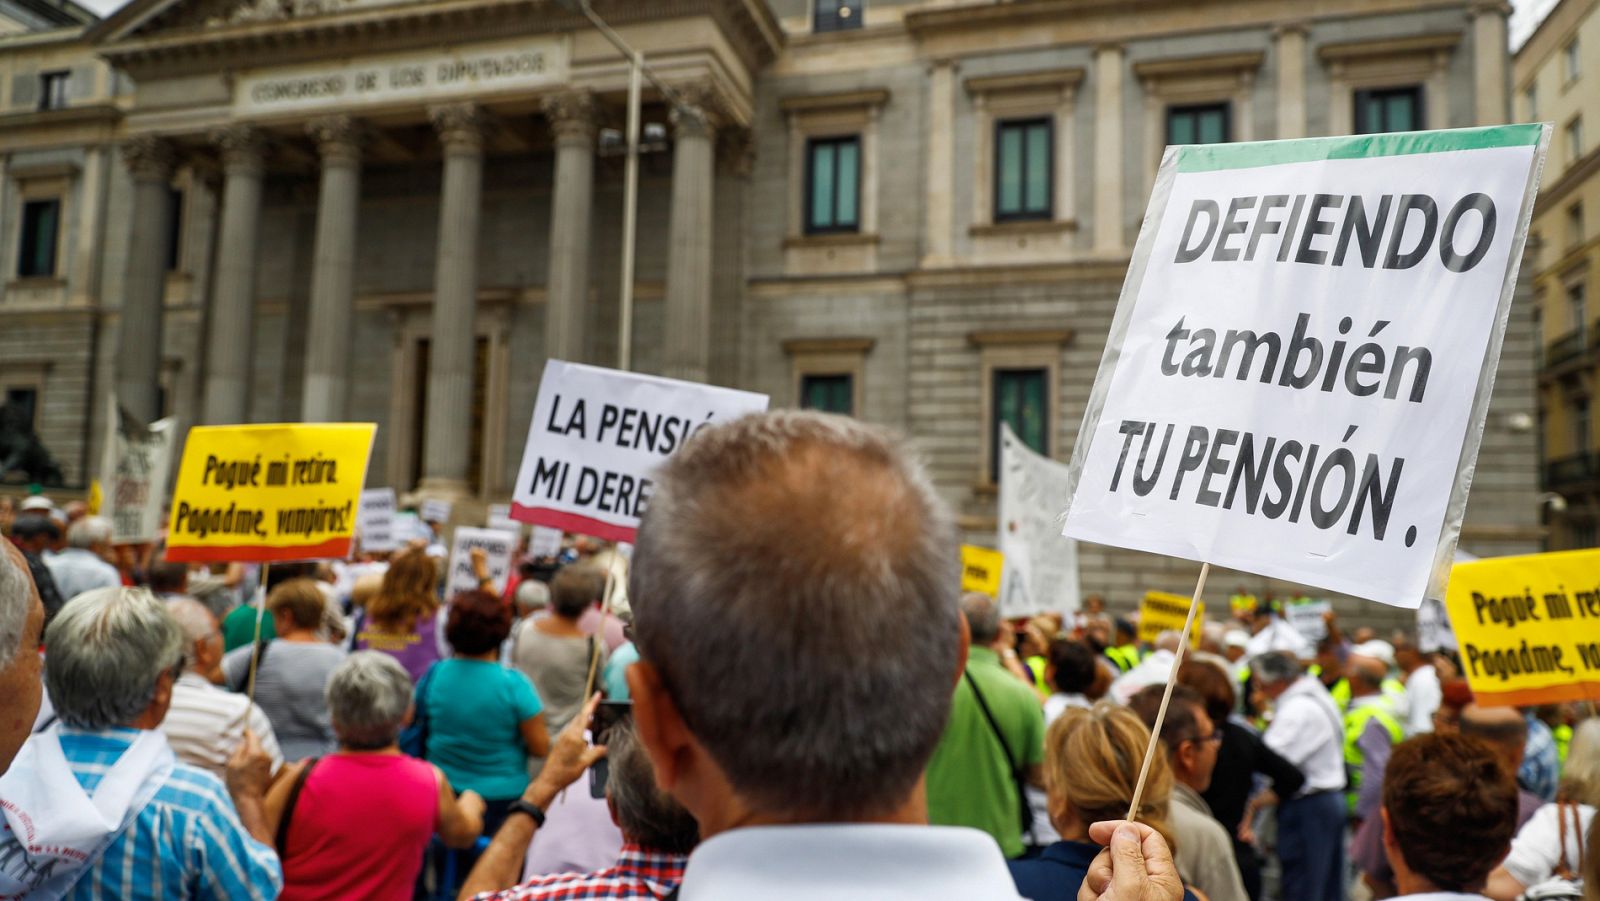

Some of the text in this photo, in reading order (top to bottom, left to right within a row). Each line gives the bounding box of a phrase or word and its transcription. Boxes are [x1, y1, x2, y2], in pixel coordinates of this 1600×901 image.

[251, 52, 545, 102] CONGRESO DE LOS DIPUTADOS
[1173, 192, 1498, 273] DEFIENDO
[1160, 312, 1433, 403] también
[547, 394, 586, 440] LA
[202, 453, 262, 490] Pagué
[265, 453, 289, 486] mi
[530, 457, 570, 501] MI
[1109, 420, 1175, 497] TU
[1470, 586, 1541, 628] Pagué
[1543, 585, 1573, 619] mi
